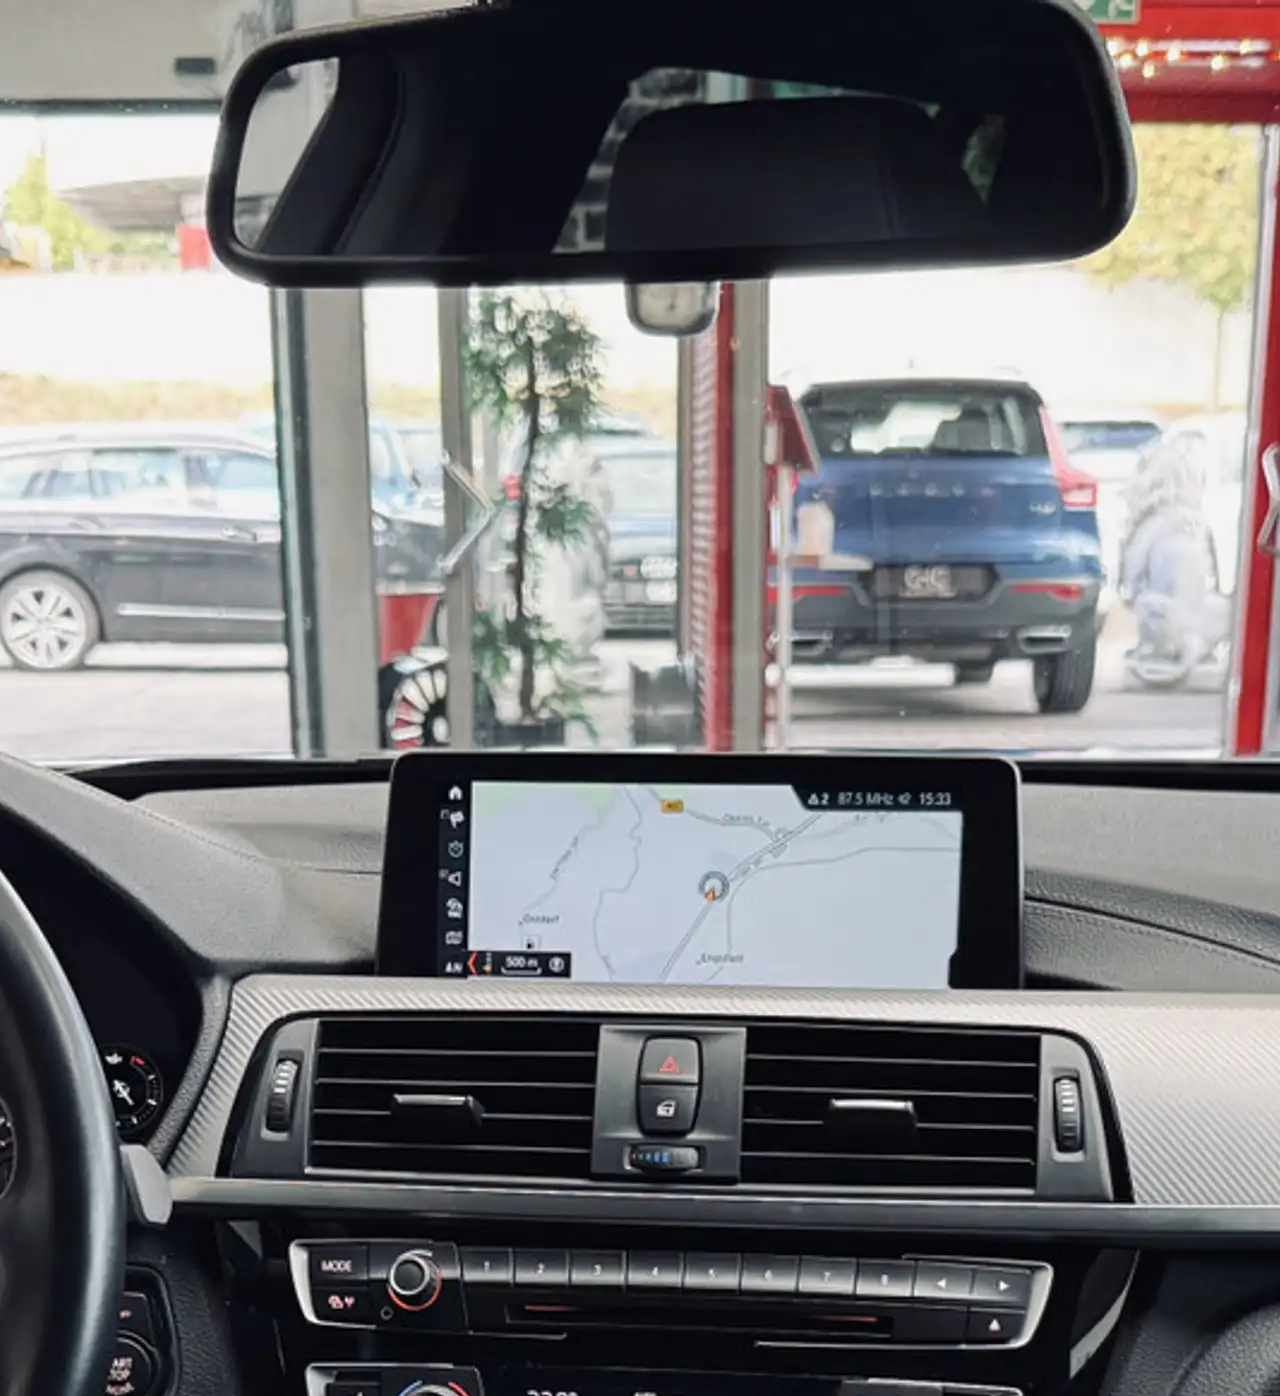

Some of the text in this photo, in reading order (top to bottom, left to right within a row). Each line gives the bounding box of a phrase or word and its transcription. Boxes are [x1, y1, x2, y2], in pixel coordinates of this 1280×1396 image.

[837, 792, 864, 805] 87.5
[866, 792, 894, 805] MHz
[321, 1259, 353, 1273] MODE
